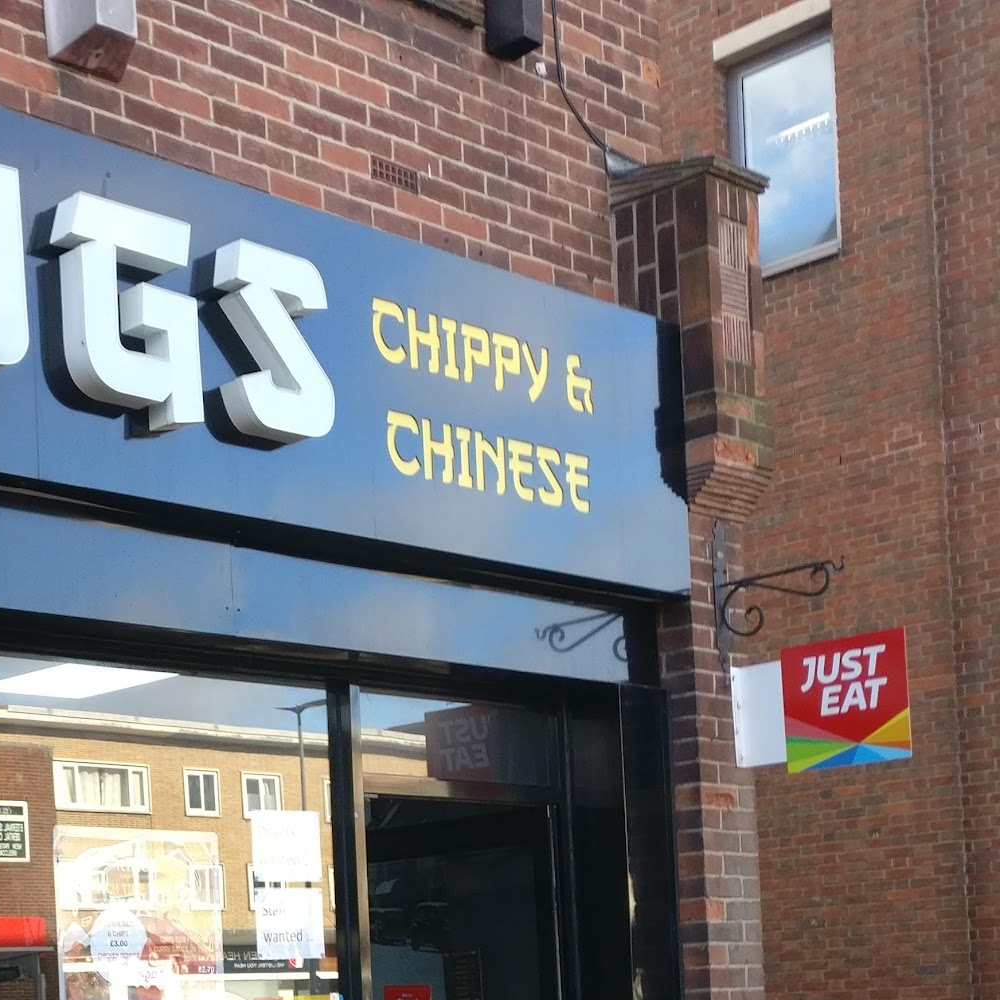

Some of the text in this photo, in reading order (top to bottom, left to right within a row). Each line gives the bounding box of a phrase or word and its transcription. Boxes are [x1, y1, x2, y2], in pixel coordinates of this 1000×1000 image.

[371, 297, 595, 415] CHIPPY &
[386, 410, 591, 514] CHINESE
[800, 644, 887, 693] JUST
[820, 676, 888, 718] EAT
[263, 929, 303, 943] wanted
